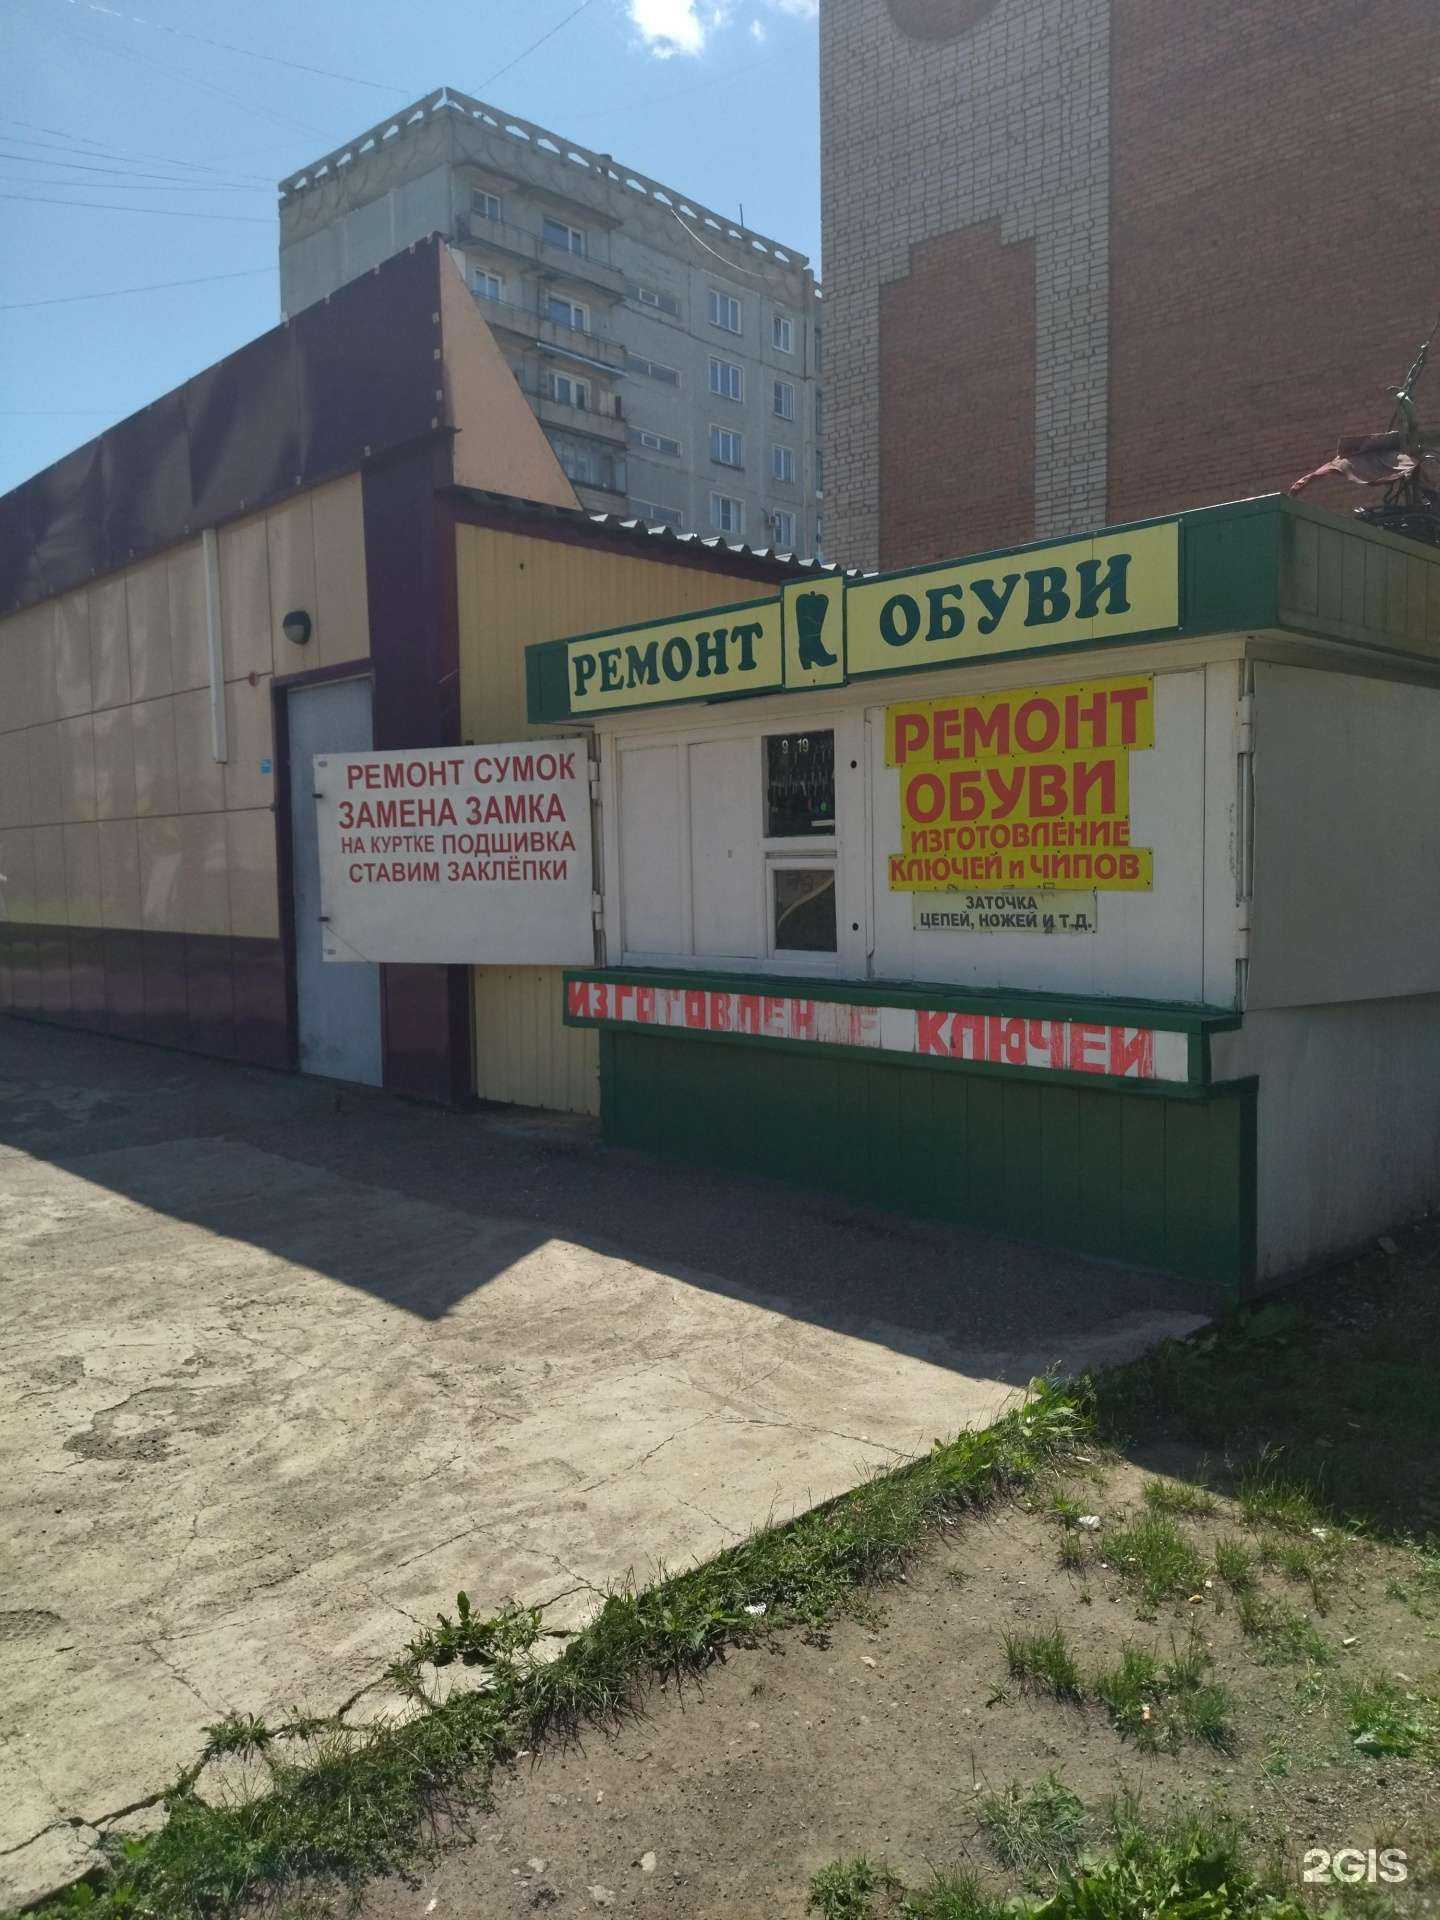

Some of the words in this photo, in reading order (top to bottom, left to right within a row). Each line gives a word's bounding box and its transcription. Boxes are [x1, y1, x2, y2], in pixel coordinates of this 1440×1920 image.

[572, 621, 764, 697] РЕМОНТ
[879, 553, 1132, 646] ОБУВИ
[895, 687, 1148, 763] РЕМОНТ
[347, 759, 465, 789] РЕМОНТ
[474, 752, 576, 784] СУМОК
[906, 760, 1116, 823] ОБУВИ
[339, 797, 458, 829] ЗАМЕНА
[466, 793, 566, 825] ЗАМКА
[342, 836, 366, 853] НА
[371, 834, 434, 853] КУРТКЕ
[442, 830, 576, 857] ПОДШИВКА
[911, 821, 1130, 854] ИЗГОТОВЛЕНИЕ
[350, 862, 440, 883] СТАВИМ
[447, 856, 568, 882] ЗАКЛЁПКИ
[891, 851, 1003, 882] КЛЮЧЕЙ
[1031, 854, 1140, 881] ЧИПОВ
[966, 895, 1038, 910] ЗАТОЧКА
[920, 910, 975, 930] ЦЕПЕЙ,
[979, 910, 1038, 928] НОЖЕЙ
[1043, 914, 1055, 929] И
[568, 980, 881, 1046] ИЗГОТОВЛЕНЕ
